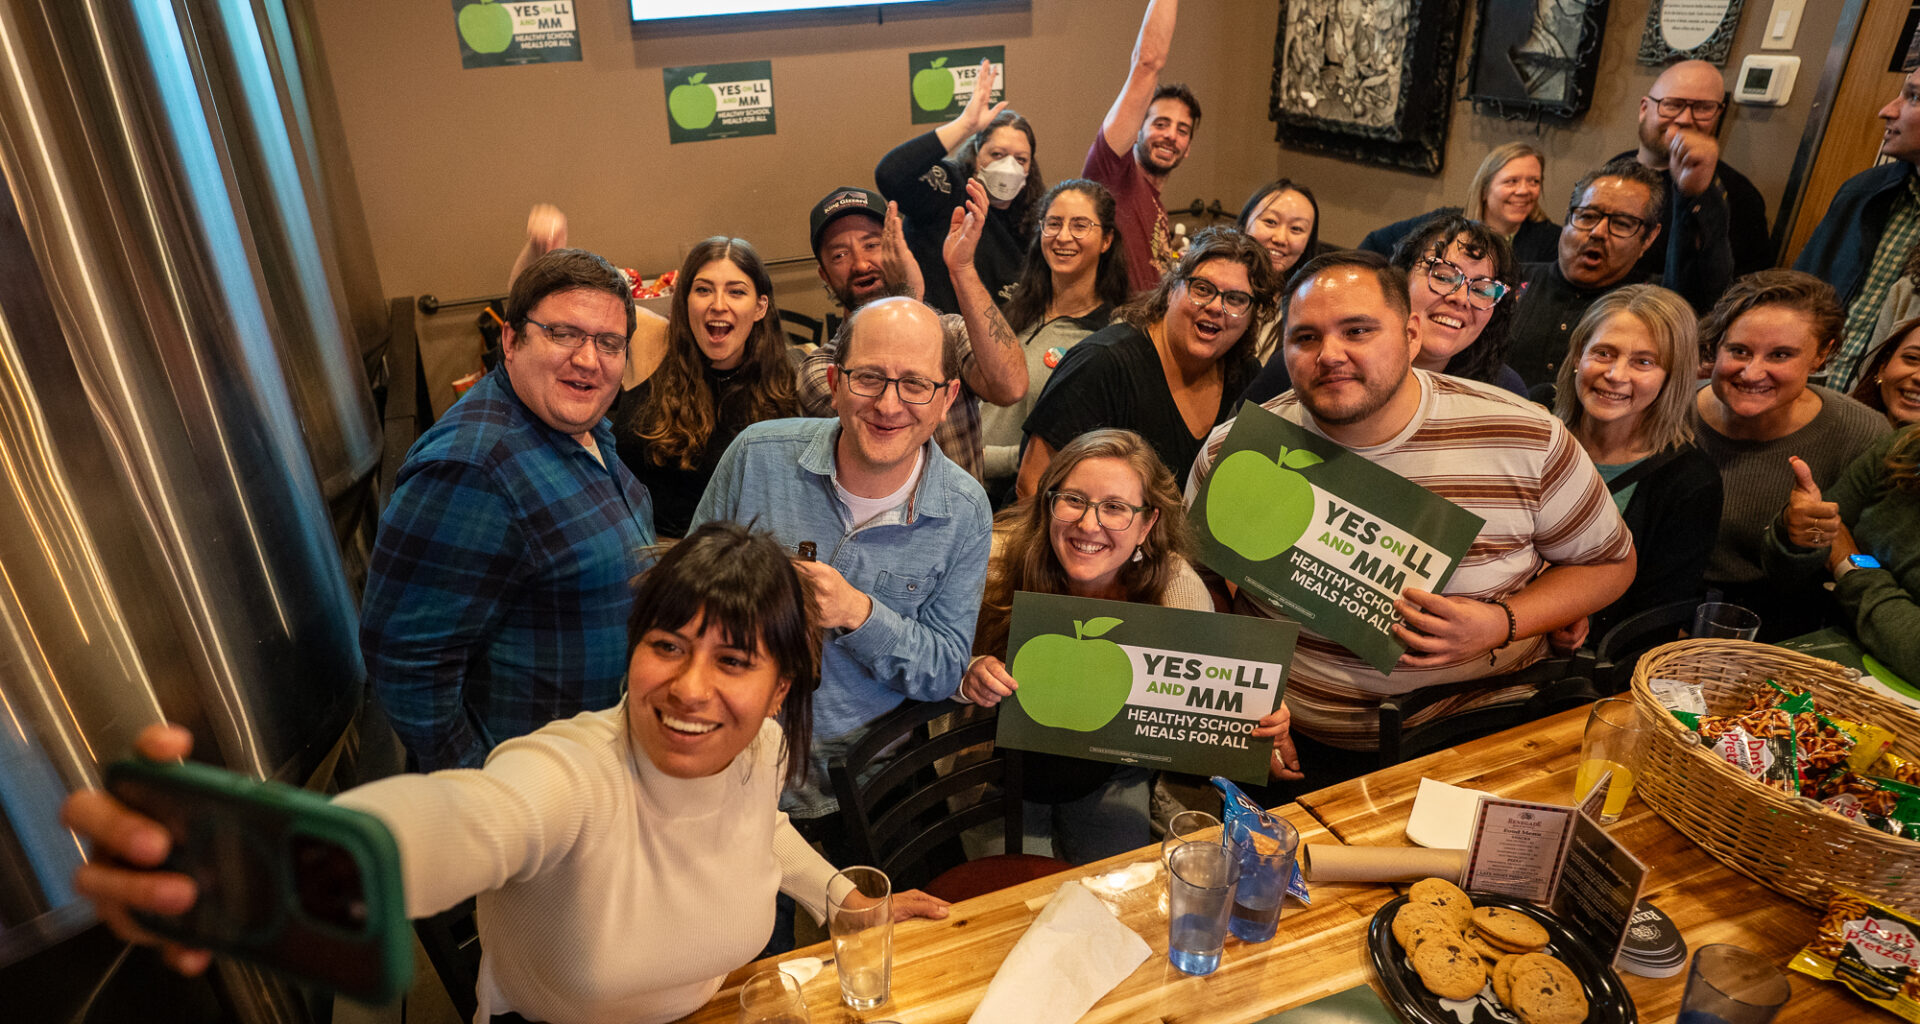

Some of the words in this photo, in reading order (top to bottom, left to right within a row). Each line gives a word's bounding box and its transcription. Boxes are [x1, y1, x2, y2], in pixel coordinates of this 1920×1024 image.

[514, 5, 540, 17] YES
[554, 4, 569, 14] LL
[538, 18, 562, 29] MM
[957, 69, 977, 79] YES
[718, 85, 741, 96] YES
[753, 83, 767, 93] LL
[739, 96, 760, 107] MM
[1325, 500, 1381, 545] YES
[1380, 535, 1407, 557] ON
[1402, 544, 1433, 580] LL
[1290, 551, 1355, 592] HEALTHY
[1317, 531, 1355, 556] AND
[1349, 550, 1407, 596] MM
[1290, 570, 1339, 603] MEALS
[1339, 595, 1366, 620] FOR
[1367, 614, 1391, 636] ALL
[1142, 653, 1203, 681] YES
[1205, 666, 1233, 681] ON
[1234, 666, 1269, 690] LL
[1145, 681, 1185, 696] AND
[1185, 686, 1243, 713] MM
[1127, 708, 1197, 727] HEALTHY
[1135, 723, 1186, 741] MEALS
[1188, 730, 1219, 746] FOR
[1221, 737, 1249, 750] ALL
[1724, 733, 1739, 764] Pretz
[1749, 740, 1765, 775] Dot's
[1864, 919, 1916, 949] Dot's
